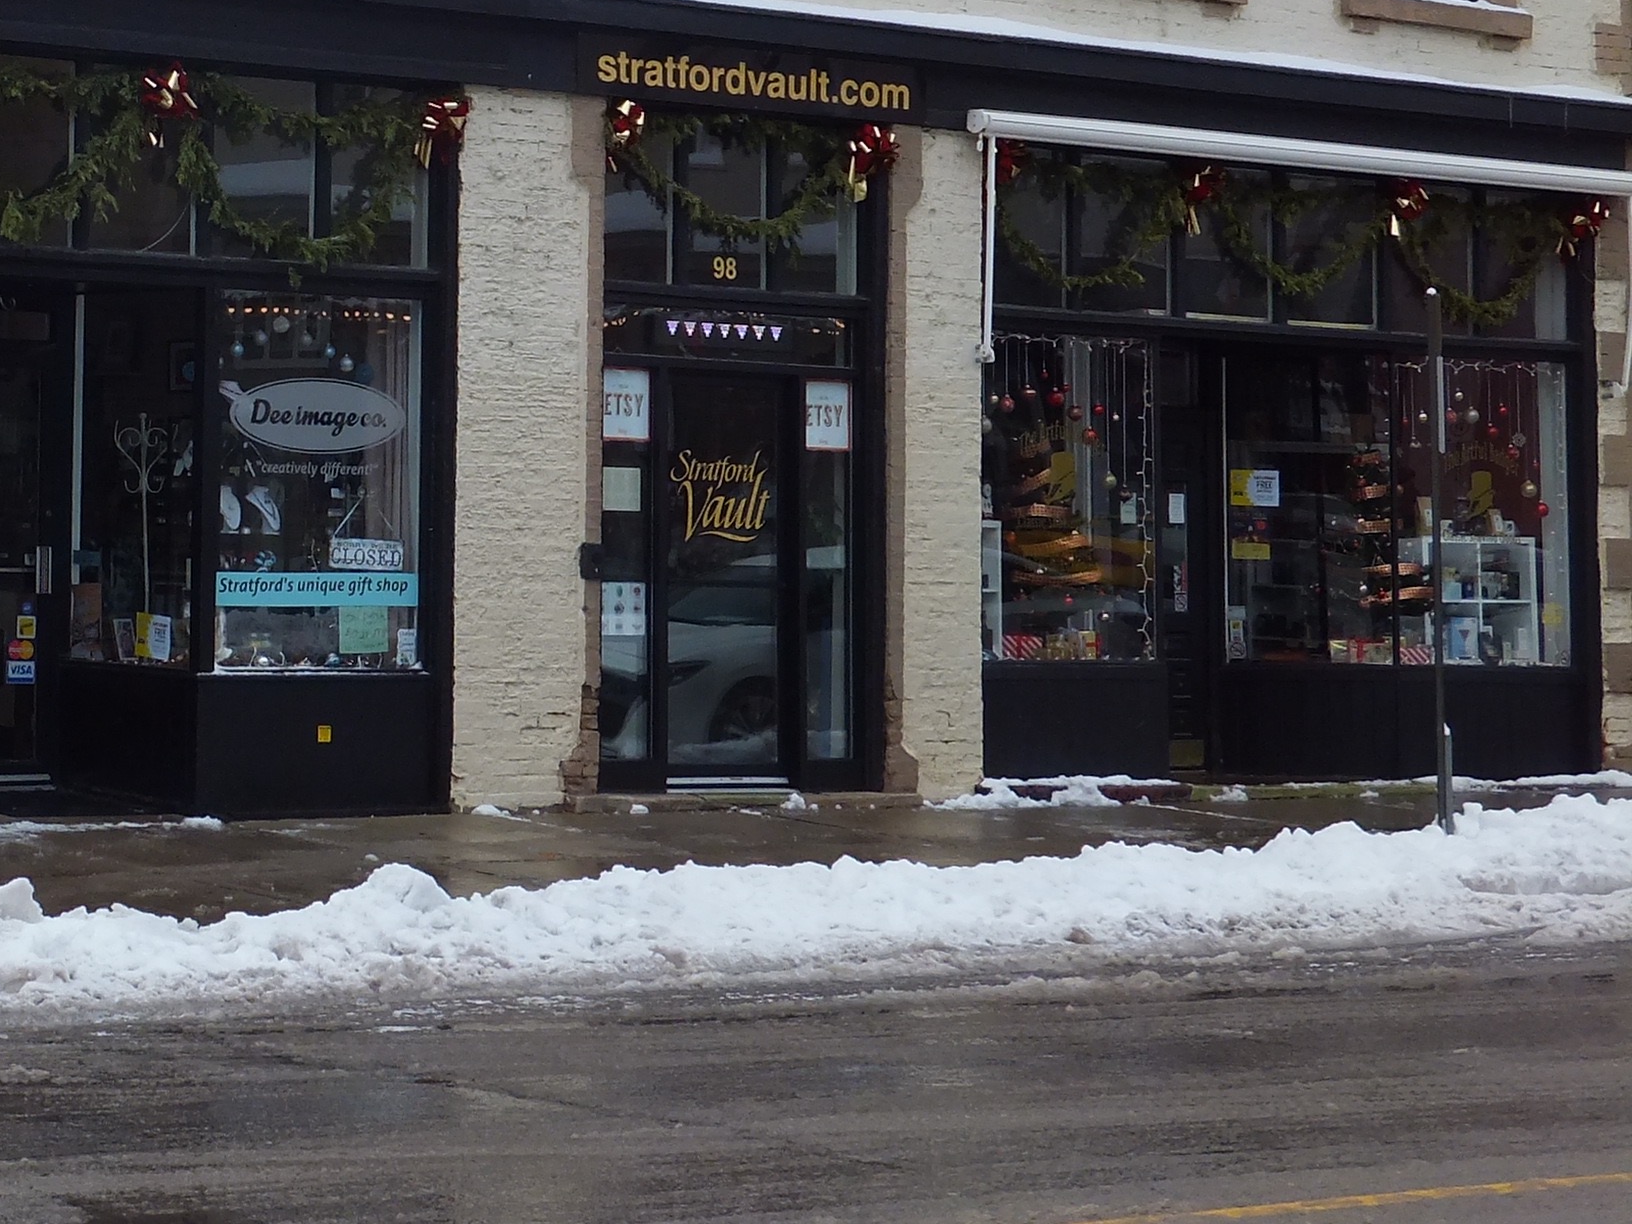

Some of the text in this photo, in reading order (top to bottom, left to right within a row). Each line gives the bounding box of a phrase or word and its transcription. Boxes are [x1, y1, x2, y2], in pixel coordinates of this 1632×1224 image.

[597, 51, 911, 110] stratfordvault.com
[712, 256, 738, 280] 98
[250, 397, 387, 437] Dee image co.
[604, 393, 643, 417] ETSY
[805, 404, 844, 428] ETSY
[670, 449, 763, 489] Stratford
[677, 468, 771, 543] Vault
[331, 547, 402, 567] CLOSED
[218, 577, 409, 597] Stratford's unique gift shop
[10, 664, 33, 675] VISA
